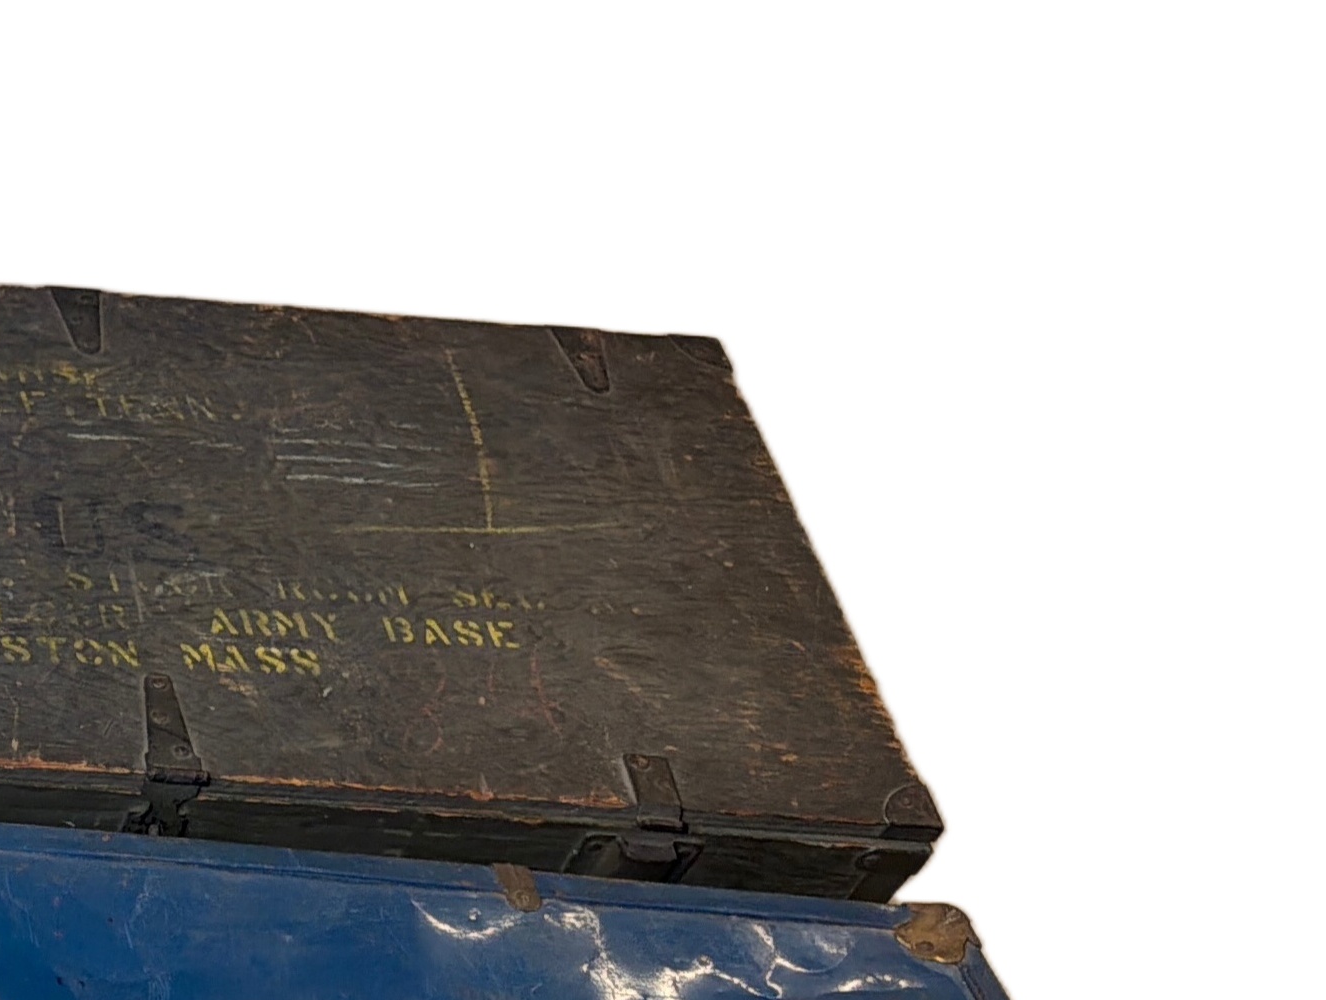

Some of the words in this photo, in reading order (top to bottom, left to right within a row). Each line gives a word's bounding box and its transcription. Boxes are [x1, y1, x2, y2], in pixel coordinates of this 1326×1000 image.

[210, 606, 337, 643] ARMY
[381, 615, 521, 650] BASE
[179, 641, 321, 676] MASS
